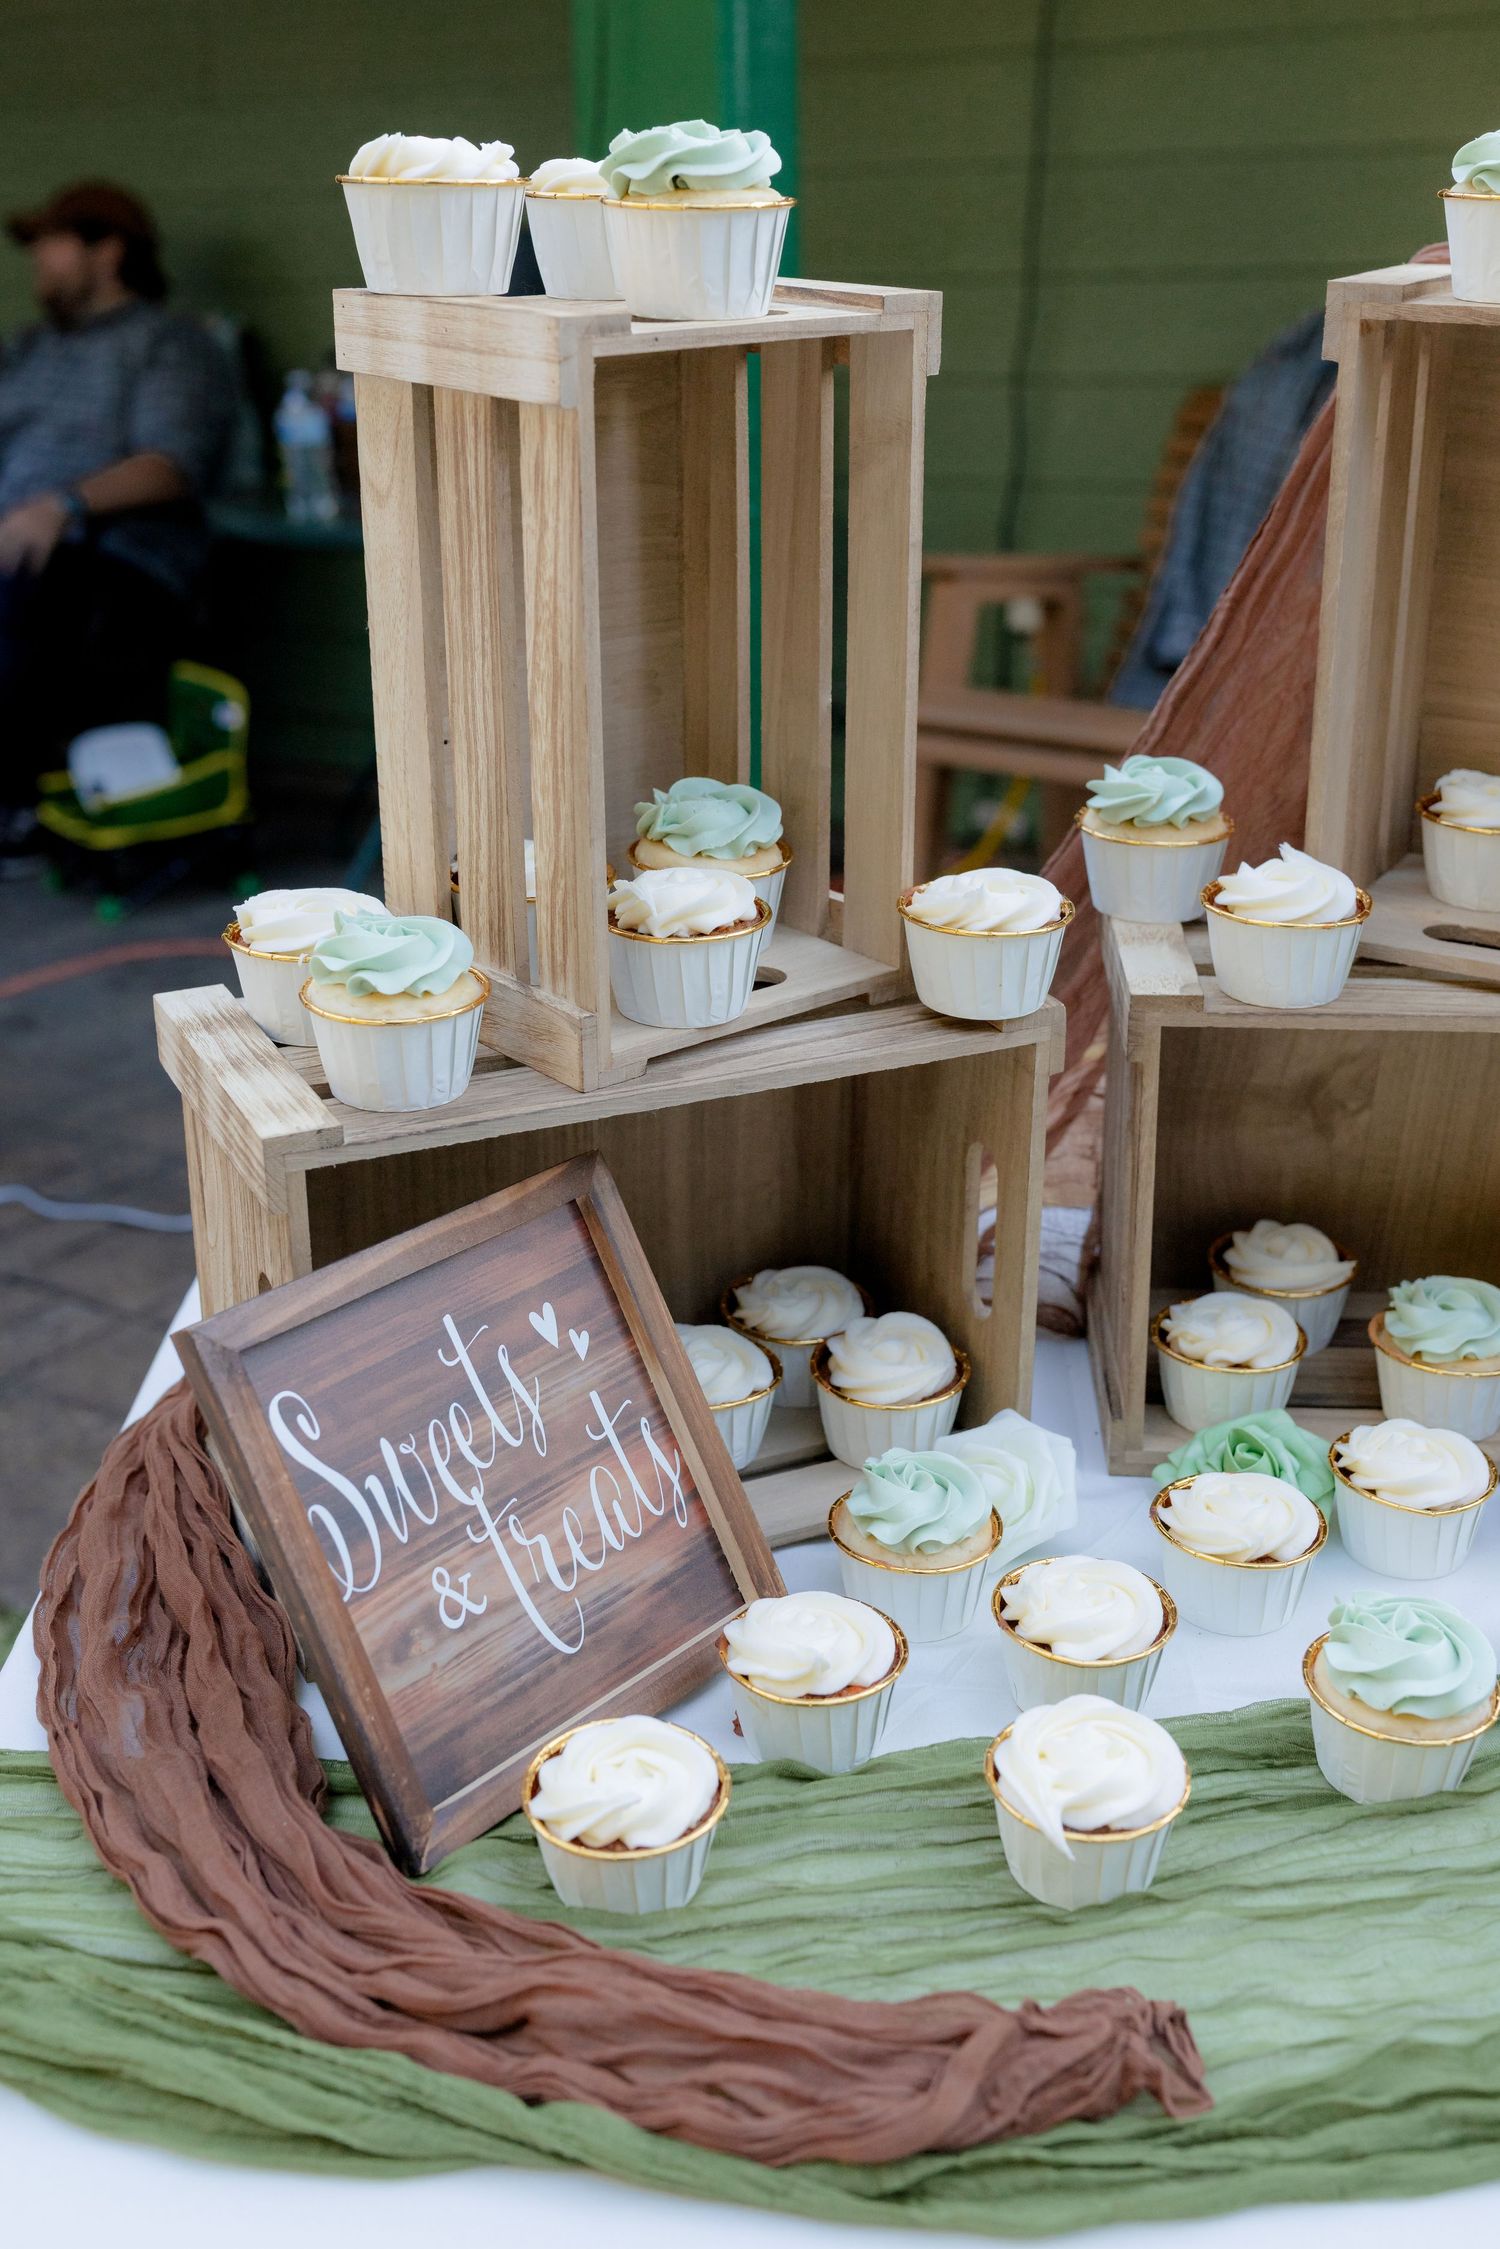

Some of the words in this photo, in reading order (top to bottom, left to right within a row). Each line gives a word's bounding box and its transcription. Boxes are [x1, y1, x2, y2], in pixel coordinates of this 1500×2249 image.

[268, 1313, 547, 1602] Sweets
[431, 1565, 488, 1630] &
[466, 1389, 689, 1654] treats
